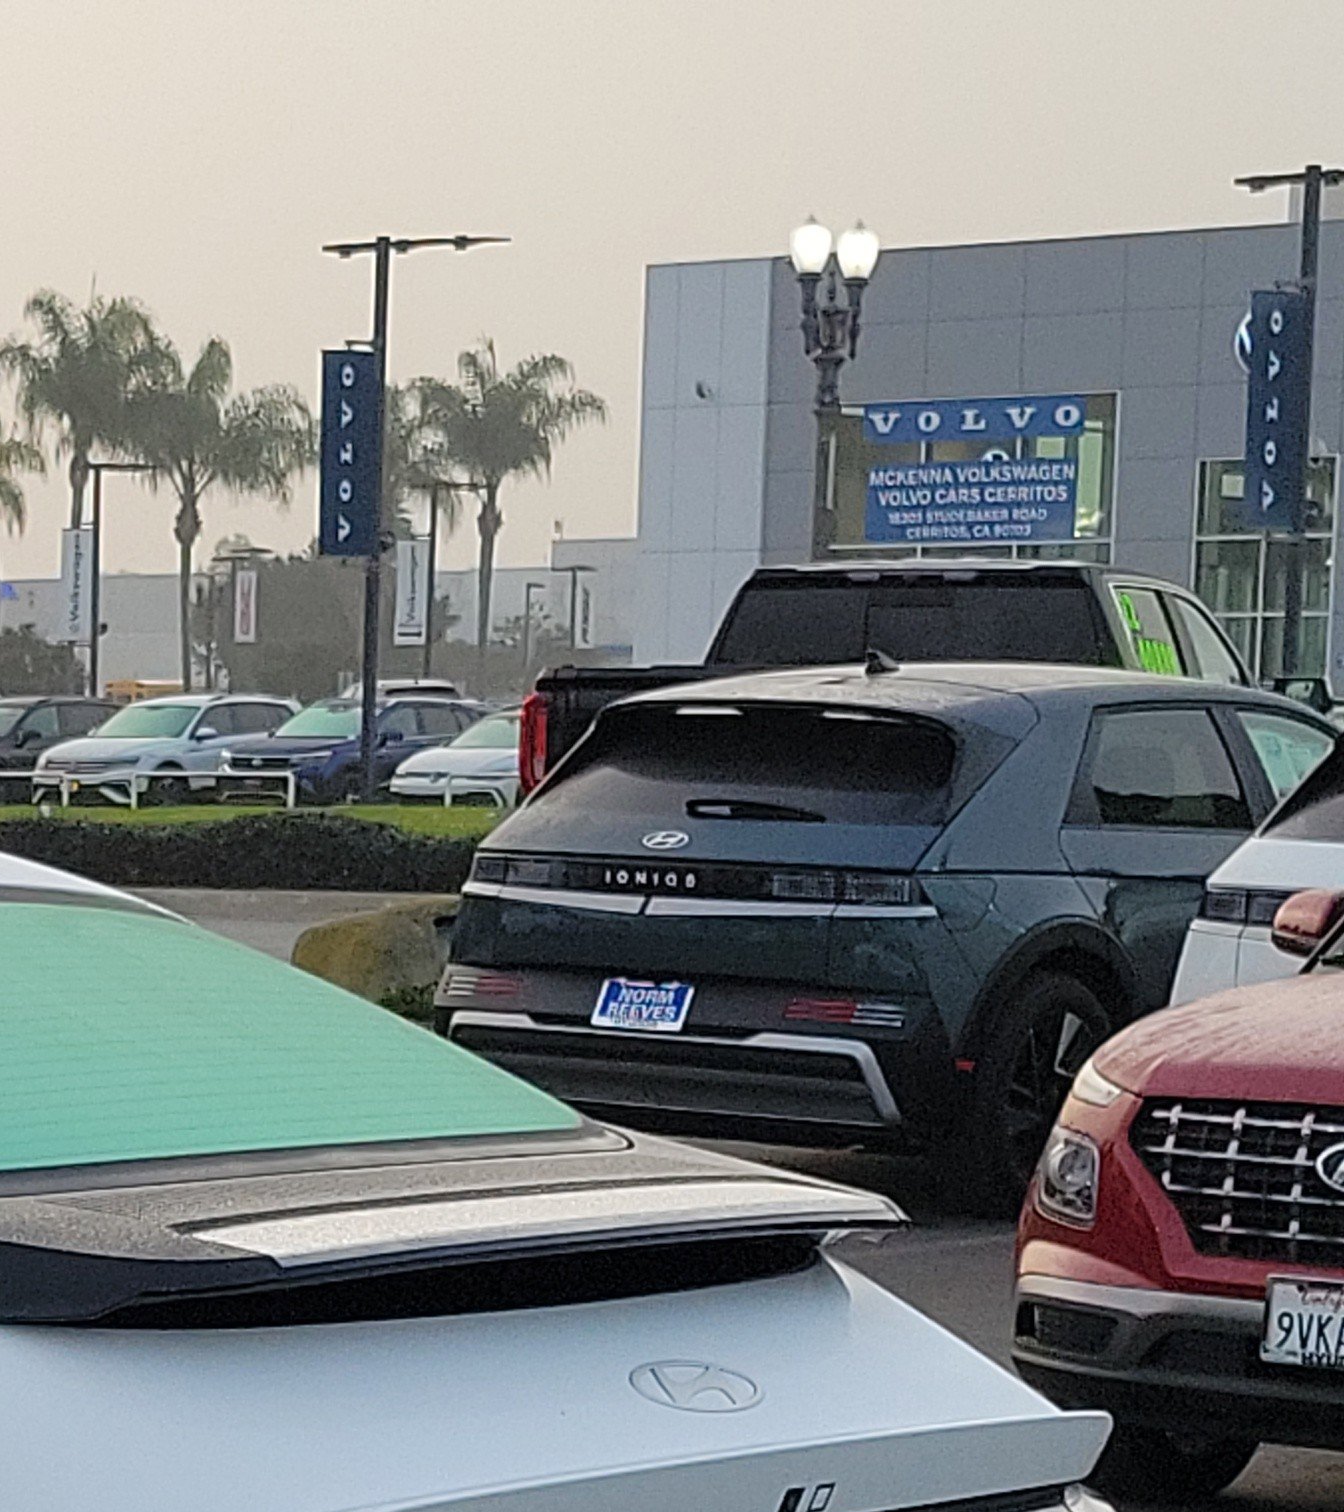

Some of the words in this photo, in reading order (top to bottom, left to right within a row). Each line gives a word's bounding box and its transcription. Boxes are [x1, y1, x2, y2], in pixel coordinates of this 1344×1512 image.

[868, 405, 1080, 434] VOLVO
[1261, 310, 1283, 511] VOLVO
[338, 364, 355, 542] VOLVO
[869, 468, 955, 486] MCKENNA
[956, 464, 1075, 483] VOLKSWAGEN
[878, 491, 931, 506] VOLVO
[934, 488, 981, 503] CARS
[984, 485, 1068, 503] CERRITOS
[1012, 507, 1048, 521] ROAD
[972, 524, 991, 537] CA
[617, 988, 675, 1004] NORM
[607, 1002, 677, 1020] REEVES
